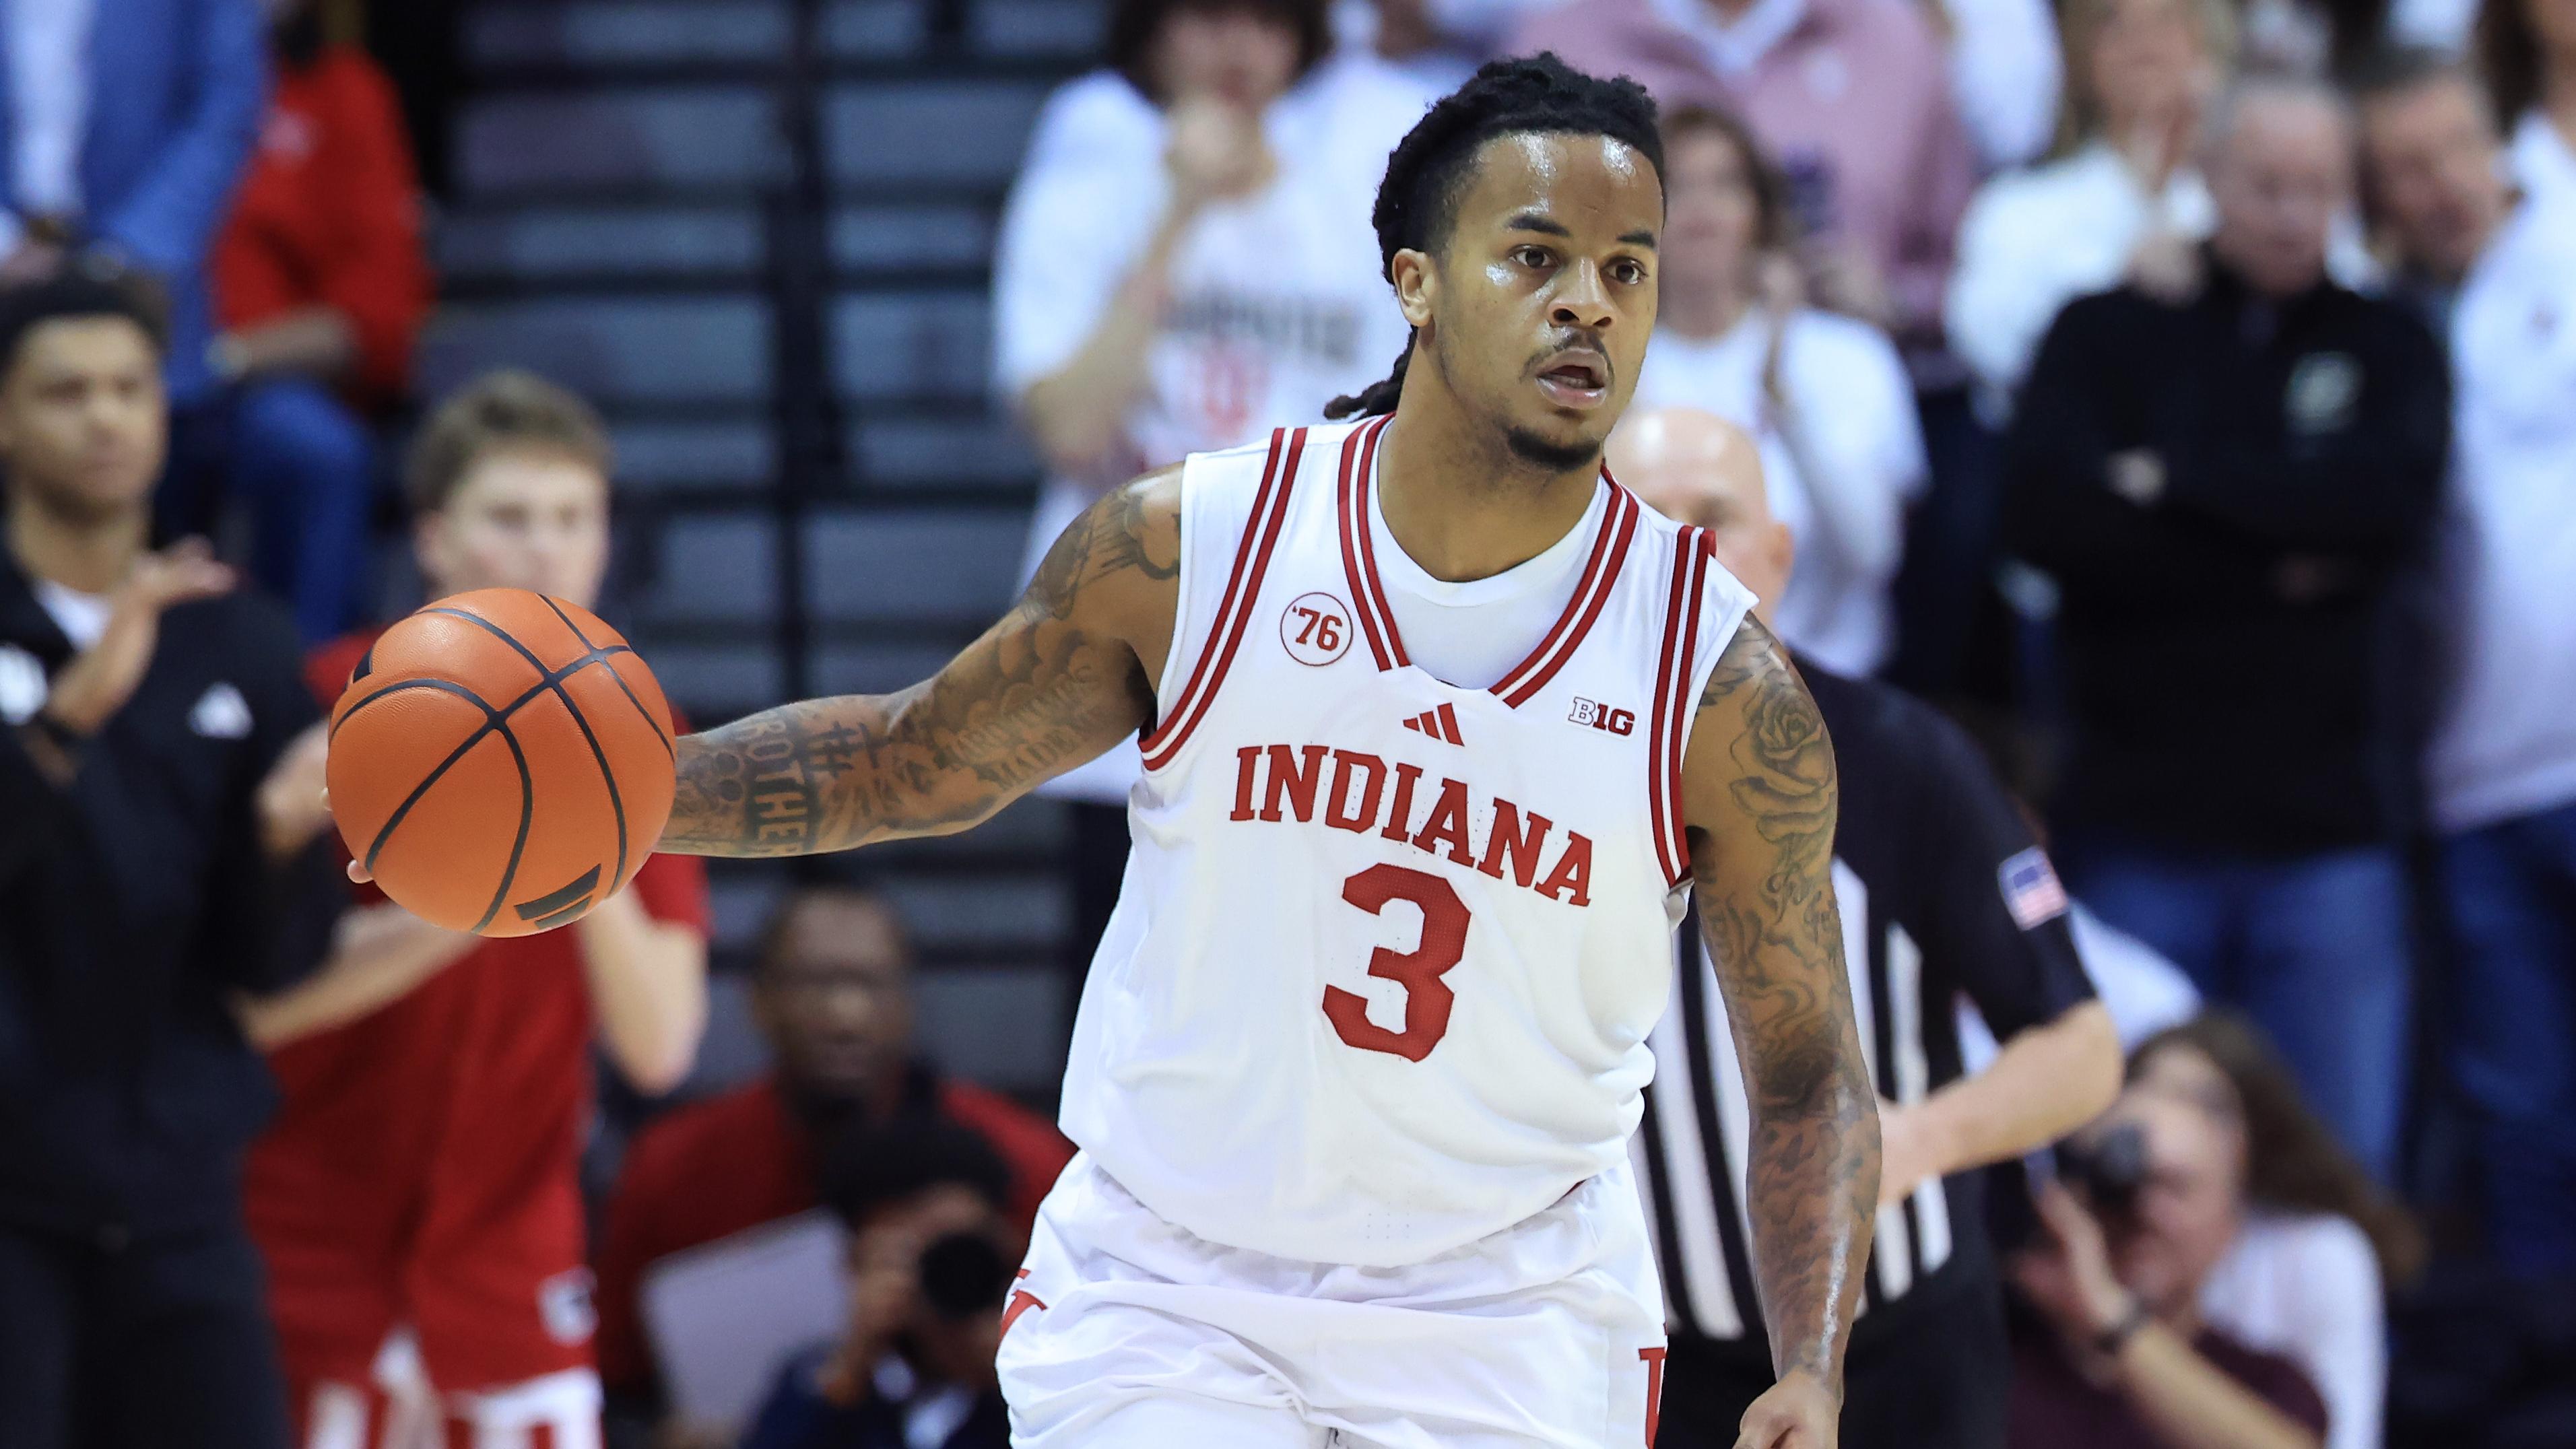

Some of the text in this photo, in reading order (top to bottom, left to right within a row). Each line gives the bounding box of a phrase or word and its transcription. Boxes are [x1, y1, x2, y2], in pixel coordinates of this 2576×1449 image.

[1292, 605, 1343, 652] '76
[1230, 744, 1593, 907] INDIANA
[1322, 863, 1472, 1063] 3
